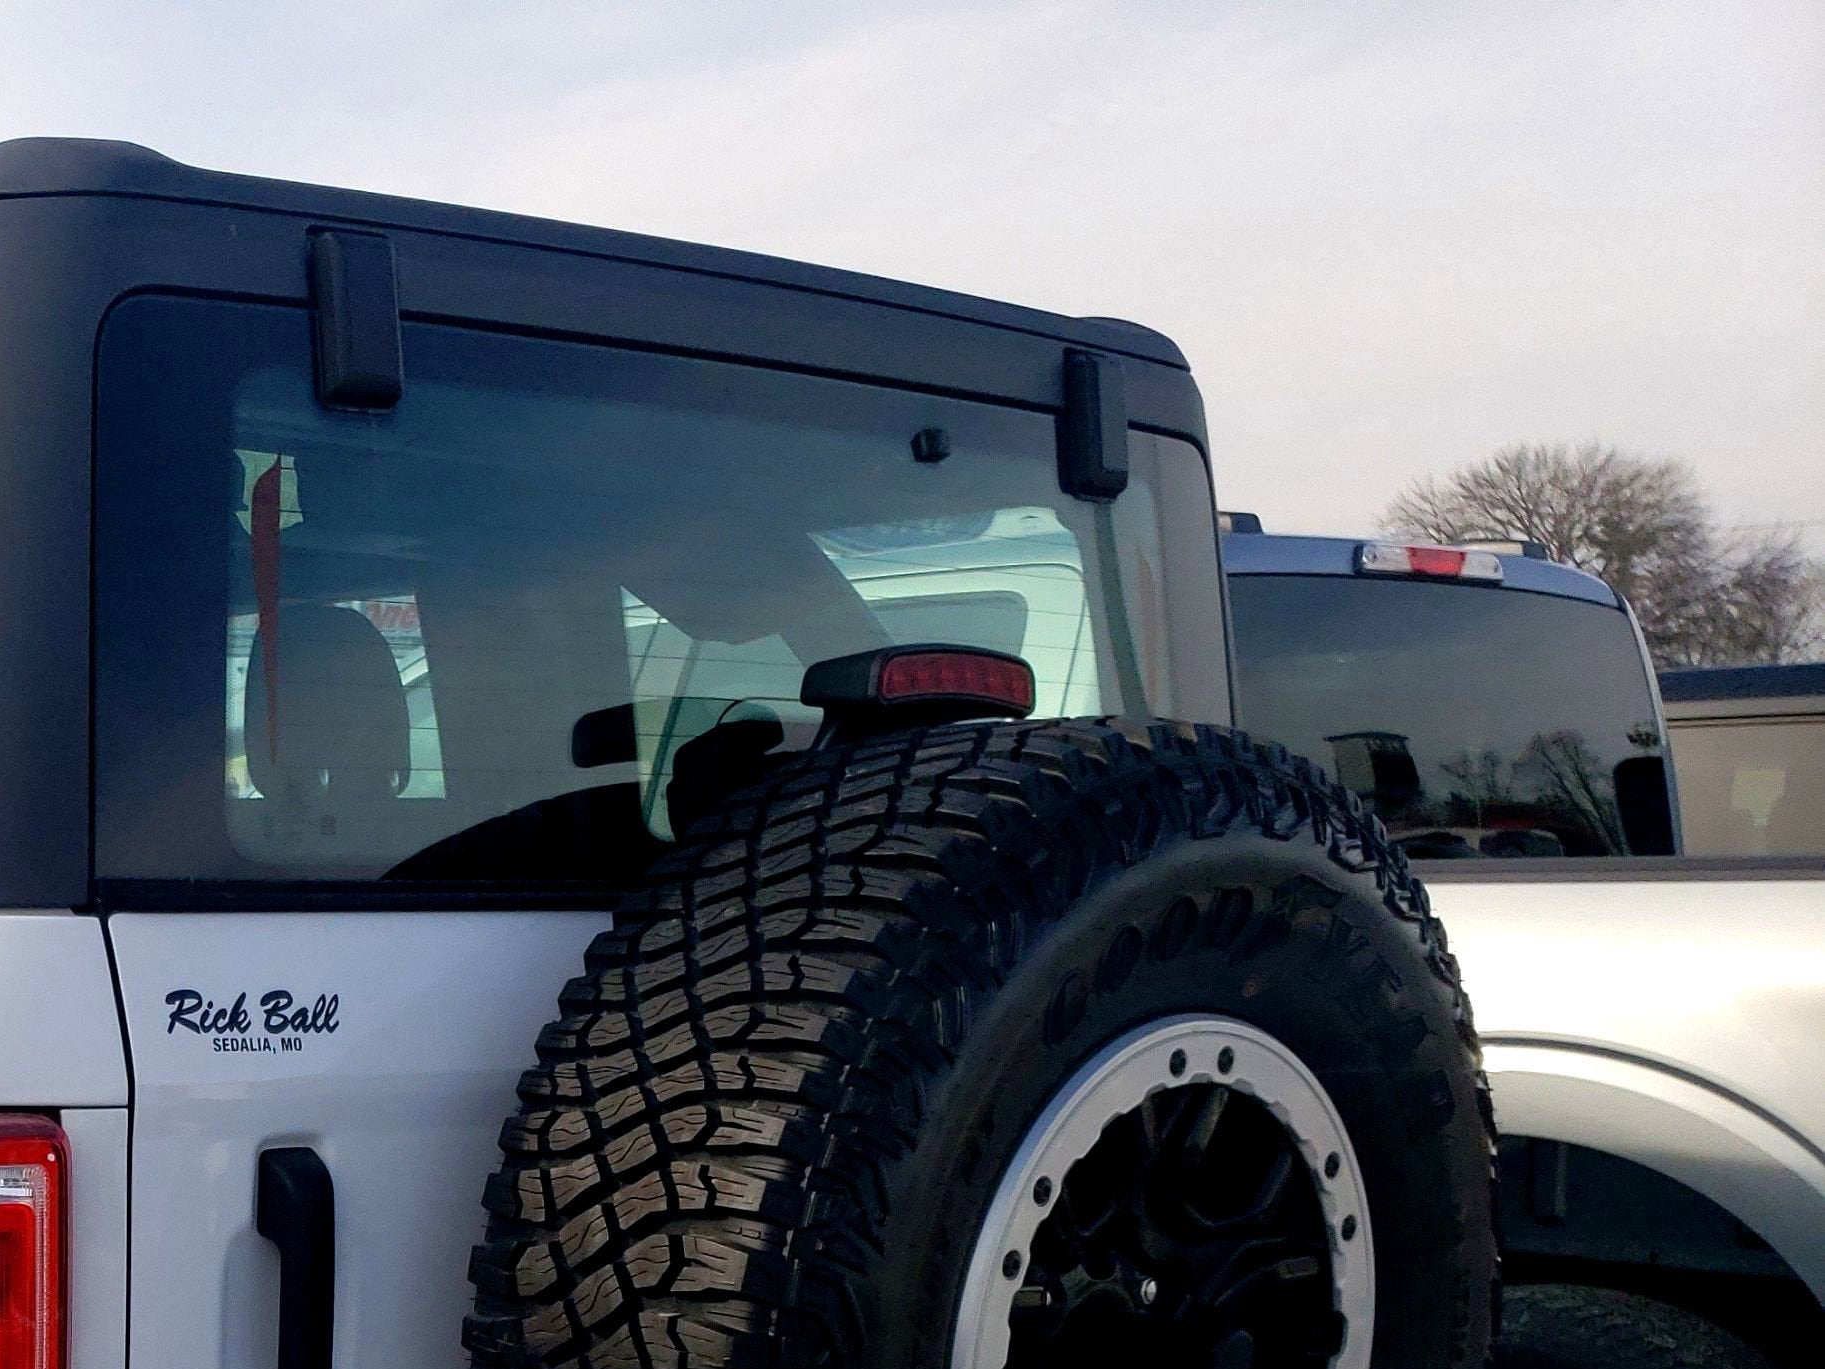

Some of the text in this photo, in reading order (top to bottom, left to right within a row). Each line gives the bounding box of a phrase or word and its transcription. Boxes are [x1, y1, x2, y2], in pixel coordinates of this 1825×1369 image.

[165, 988, 340, 1034] Rick Ball
[212, 1037, 303, 1054] SEDALIA, MO
